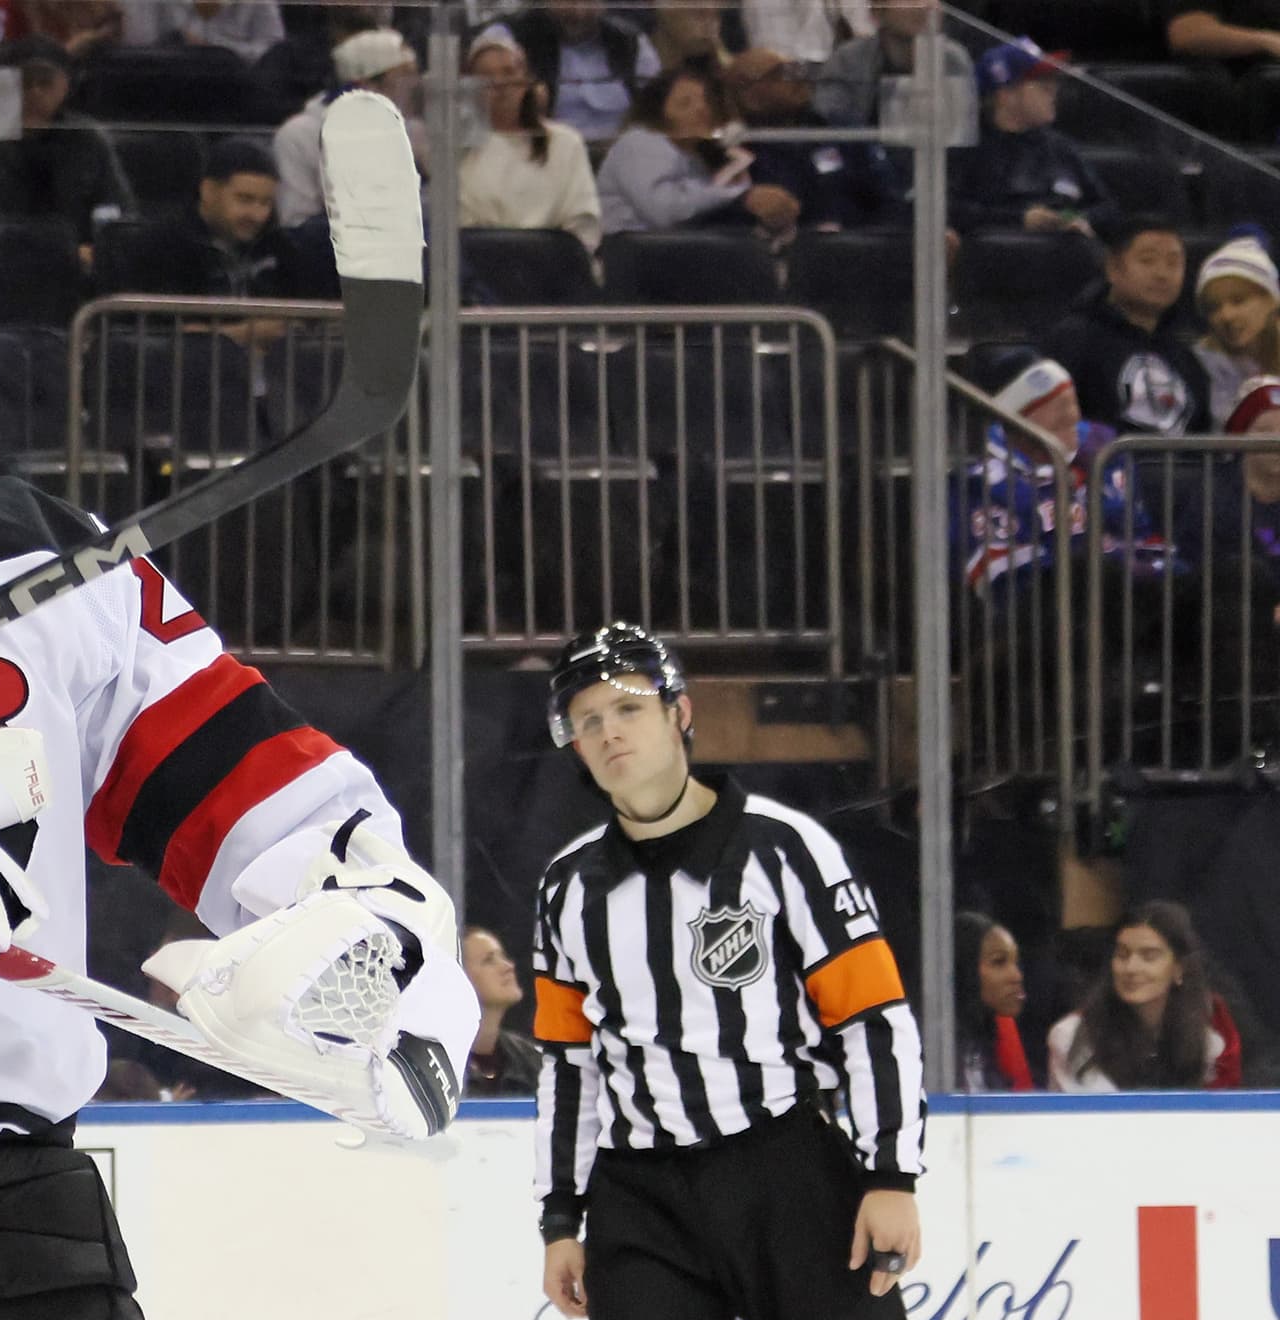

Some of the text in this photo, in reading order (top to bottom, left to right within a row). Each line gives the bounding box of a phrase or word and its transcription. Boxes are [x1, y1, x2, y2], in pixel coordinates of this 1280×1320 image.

[23, 759, 46, 807] TRUE
[709, 924, 753, 974] NHL
[426, 1047, 458, 1122] TRUE
